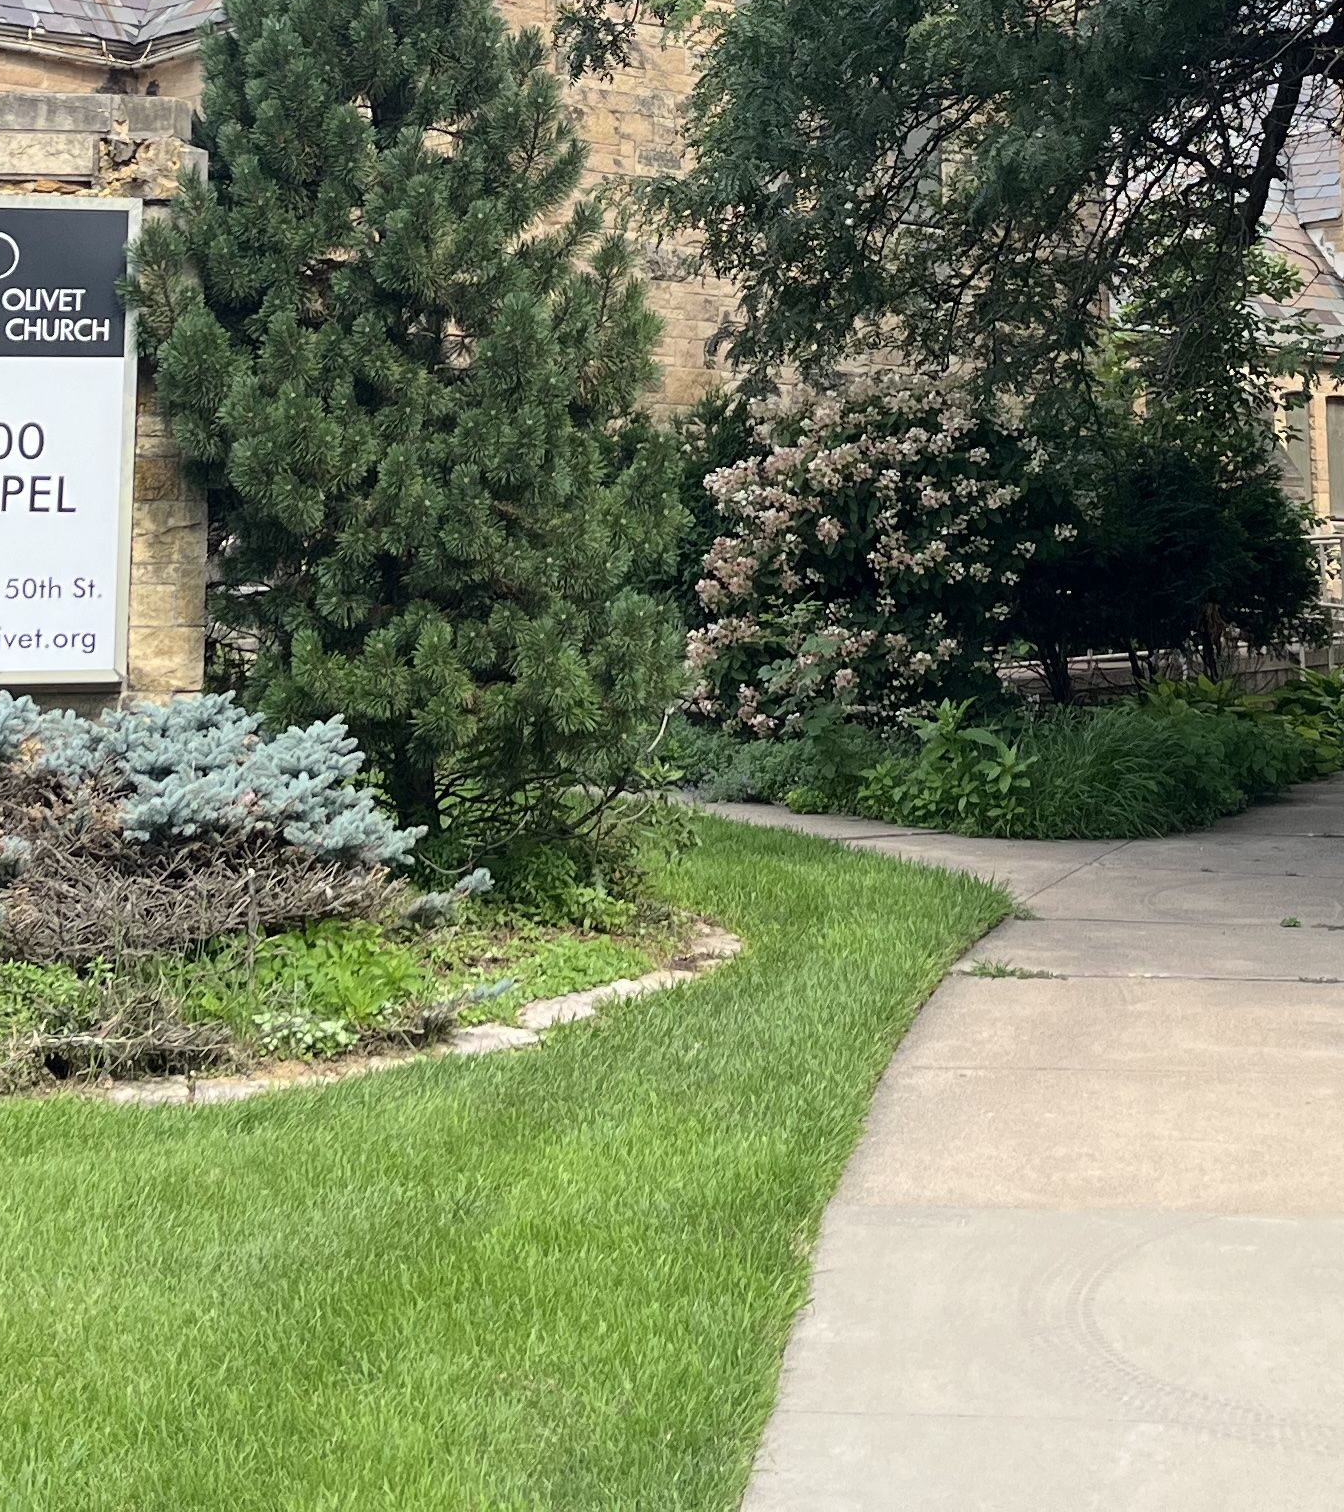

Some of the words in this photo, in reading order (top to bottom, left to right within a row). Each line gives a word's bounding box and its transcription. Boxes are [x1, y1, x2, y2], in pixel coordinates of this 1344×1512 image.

[1, 288, 86, 312] OLIVET
[5, 317, 110, 342] CHURCH
[5, 576, 62, 599] 50th
[72, 577, 103, 599] St.
